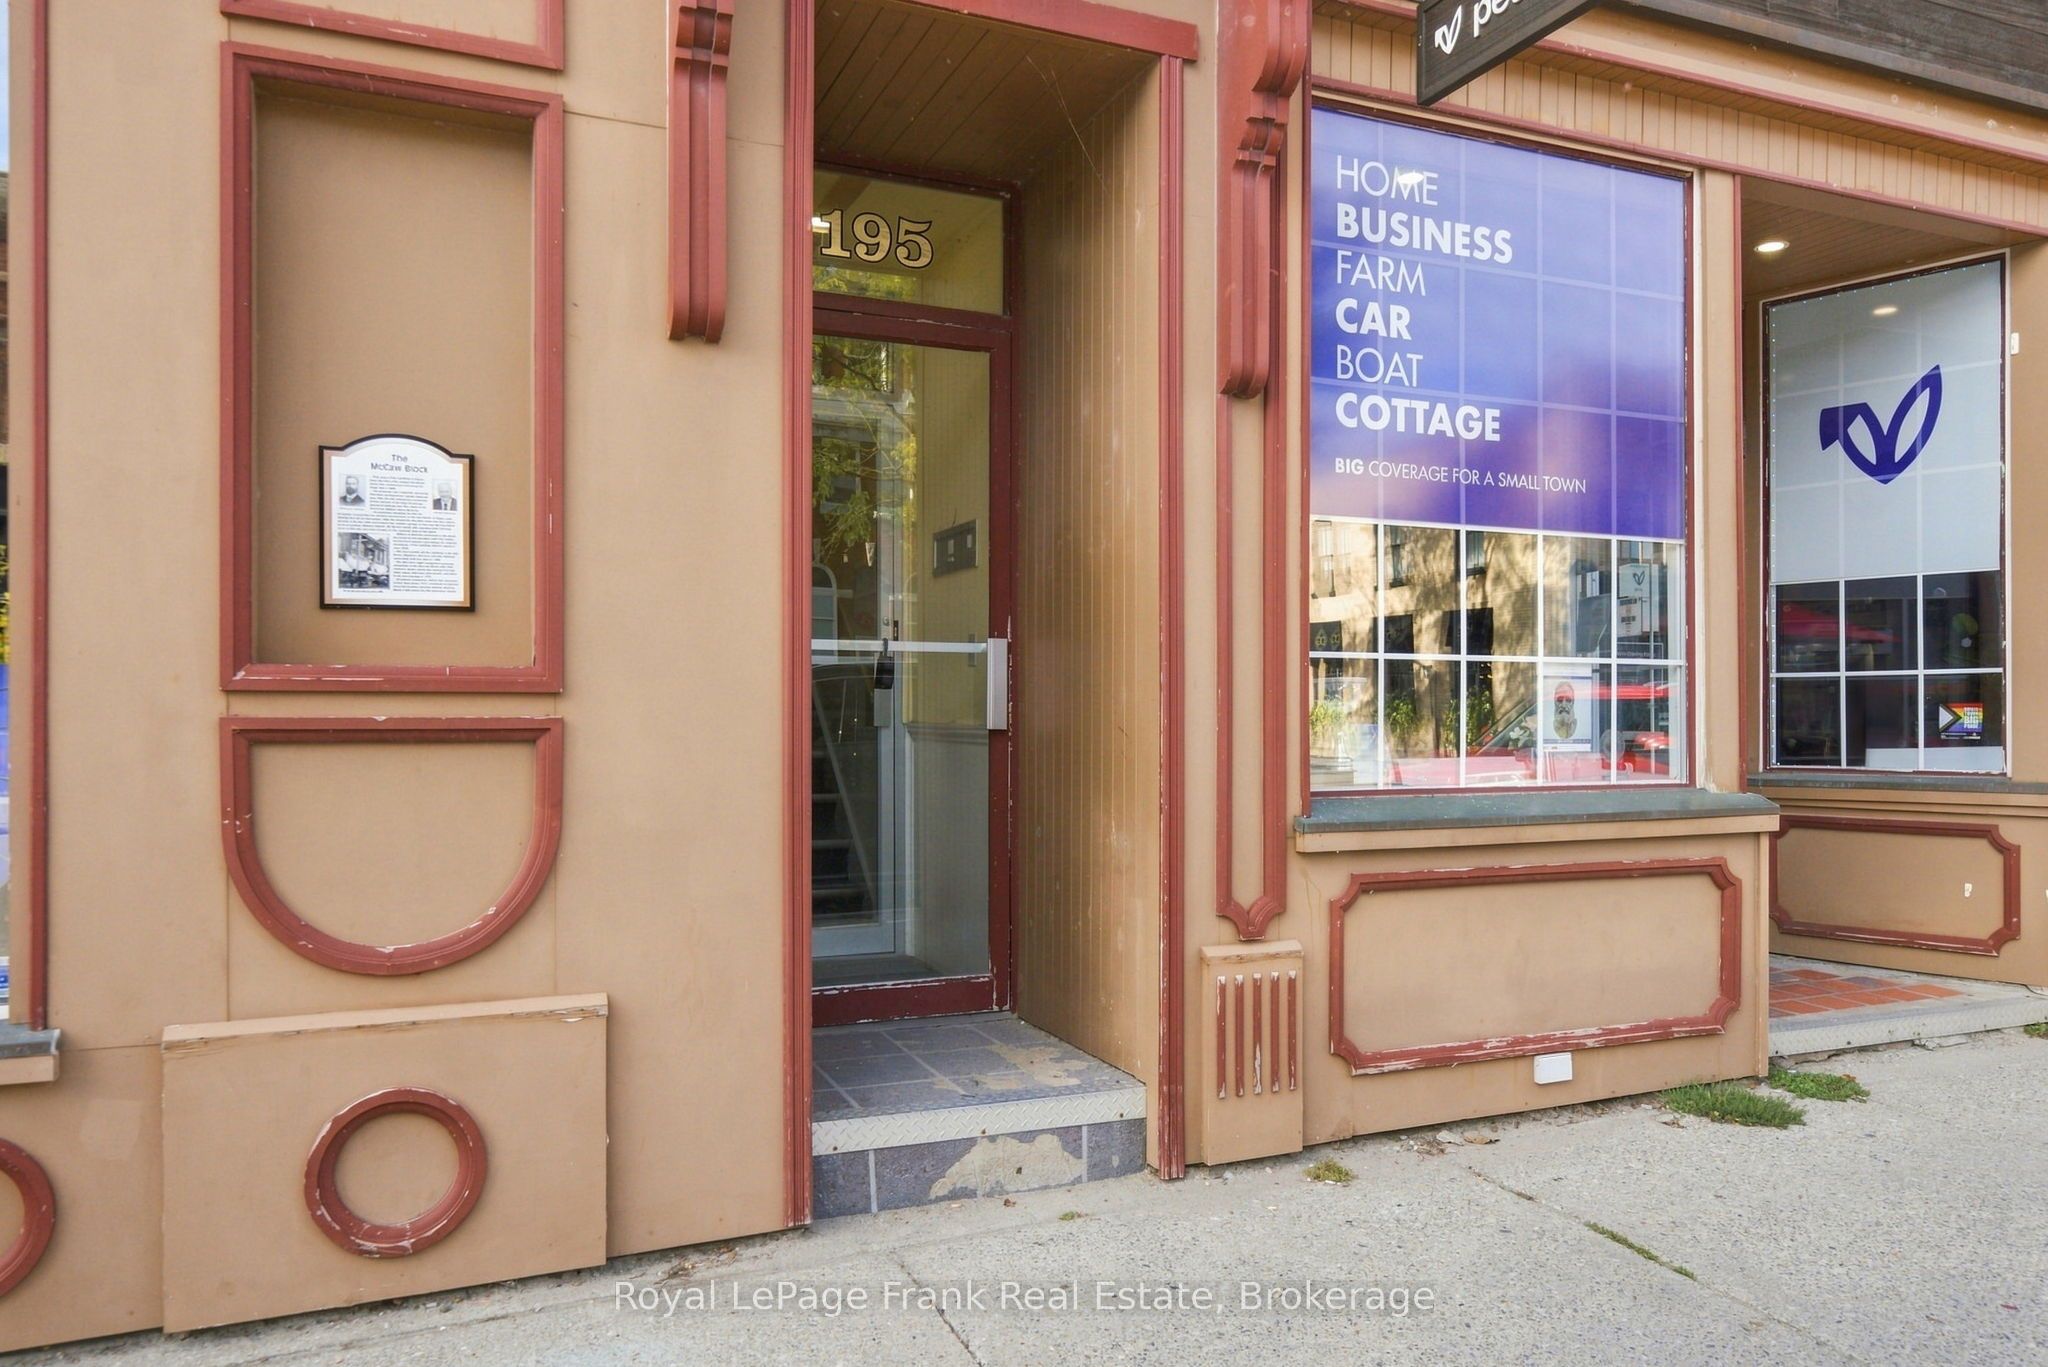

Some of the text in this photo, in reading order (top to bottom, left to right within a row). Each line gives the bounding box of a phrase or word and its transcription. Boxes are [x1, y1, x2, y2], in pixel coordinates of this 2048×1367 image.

[1473, 0, 1521, 38] pe
[1336, 154, 1439, 207] HOME
[819, 208, 934, 269] 195
[1336, 202, 1513, 265] BUSINESS
[1336, 249, 1426, 297] FARM
[1335, 297, 1412, 341] CAR
[1336, 344, 1424, 388] BOAT
[1335, 392, 1501, 442] COTTAGE
[370, 462, 428, 474] McCaw Block
[391, 454, 408, 463] The
[1335, 457, 1587, 494] BIG COVERAGE FOR A SMALL TOWN
